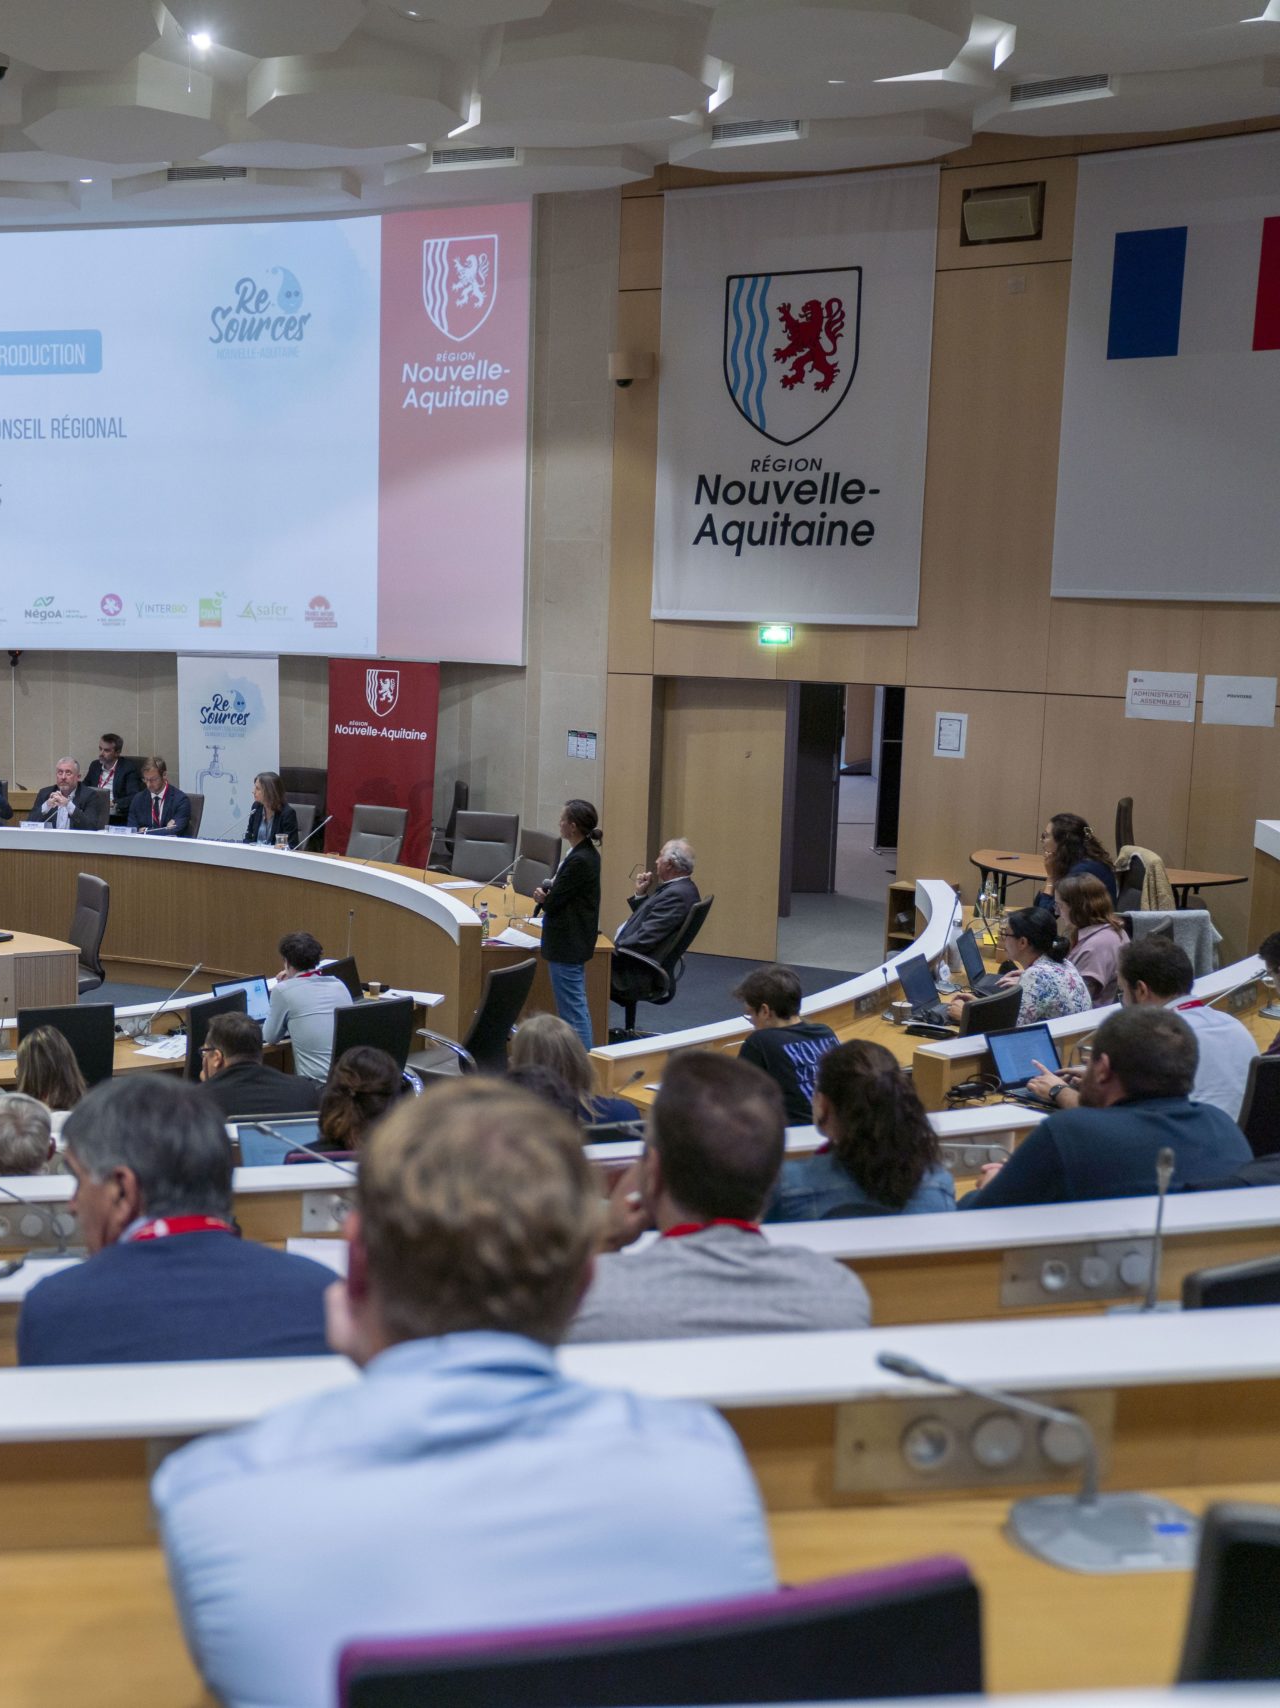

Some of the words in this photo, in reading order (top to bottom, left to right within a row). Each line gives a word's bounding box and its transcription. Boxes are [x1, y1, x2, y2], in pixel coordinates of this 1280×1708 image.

[235, 277, 271, 314] Re
[209, 306, 311, 344] Sources
[436, 351, 476, 362] RÉGION
[402, 360, 510, 383] Nouvelle-
[402, 385, 510, 414] Aquitaine
[51, 414, 127, 439] RÉGIONAL
[751, 455, 823, 472] RÉGION
[694, 472, 880, 505] Nouvelle-
[692, 511, 875, 557] Aquitaine
[24, 608, 62, 620] NégoA
[257, 603, 288, 616] safer
[212, 694, 230, 712] Re
[1134, 691, 1189, 699] ADMINISTRATION
[200, 706, 250, 725] Sources
[334, 724, 427, 741] Nouvelle-Aquitaine
